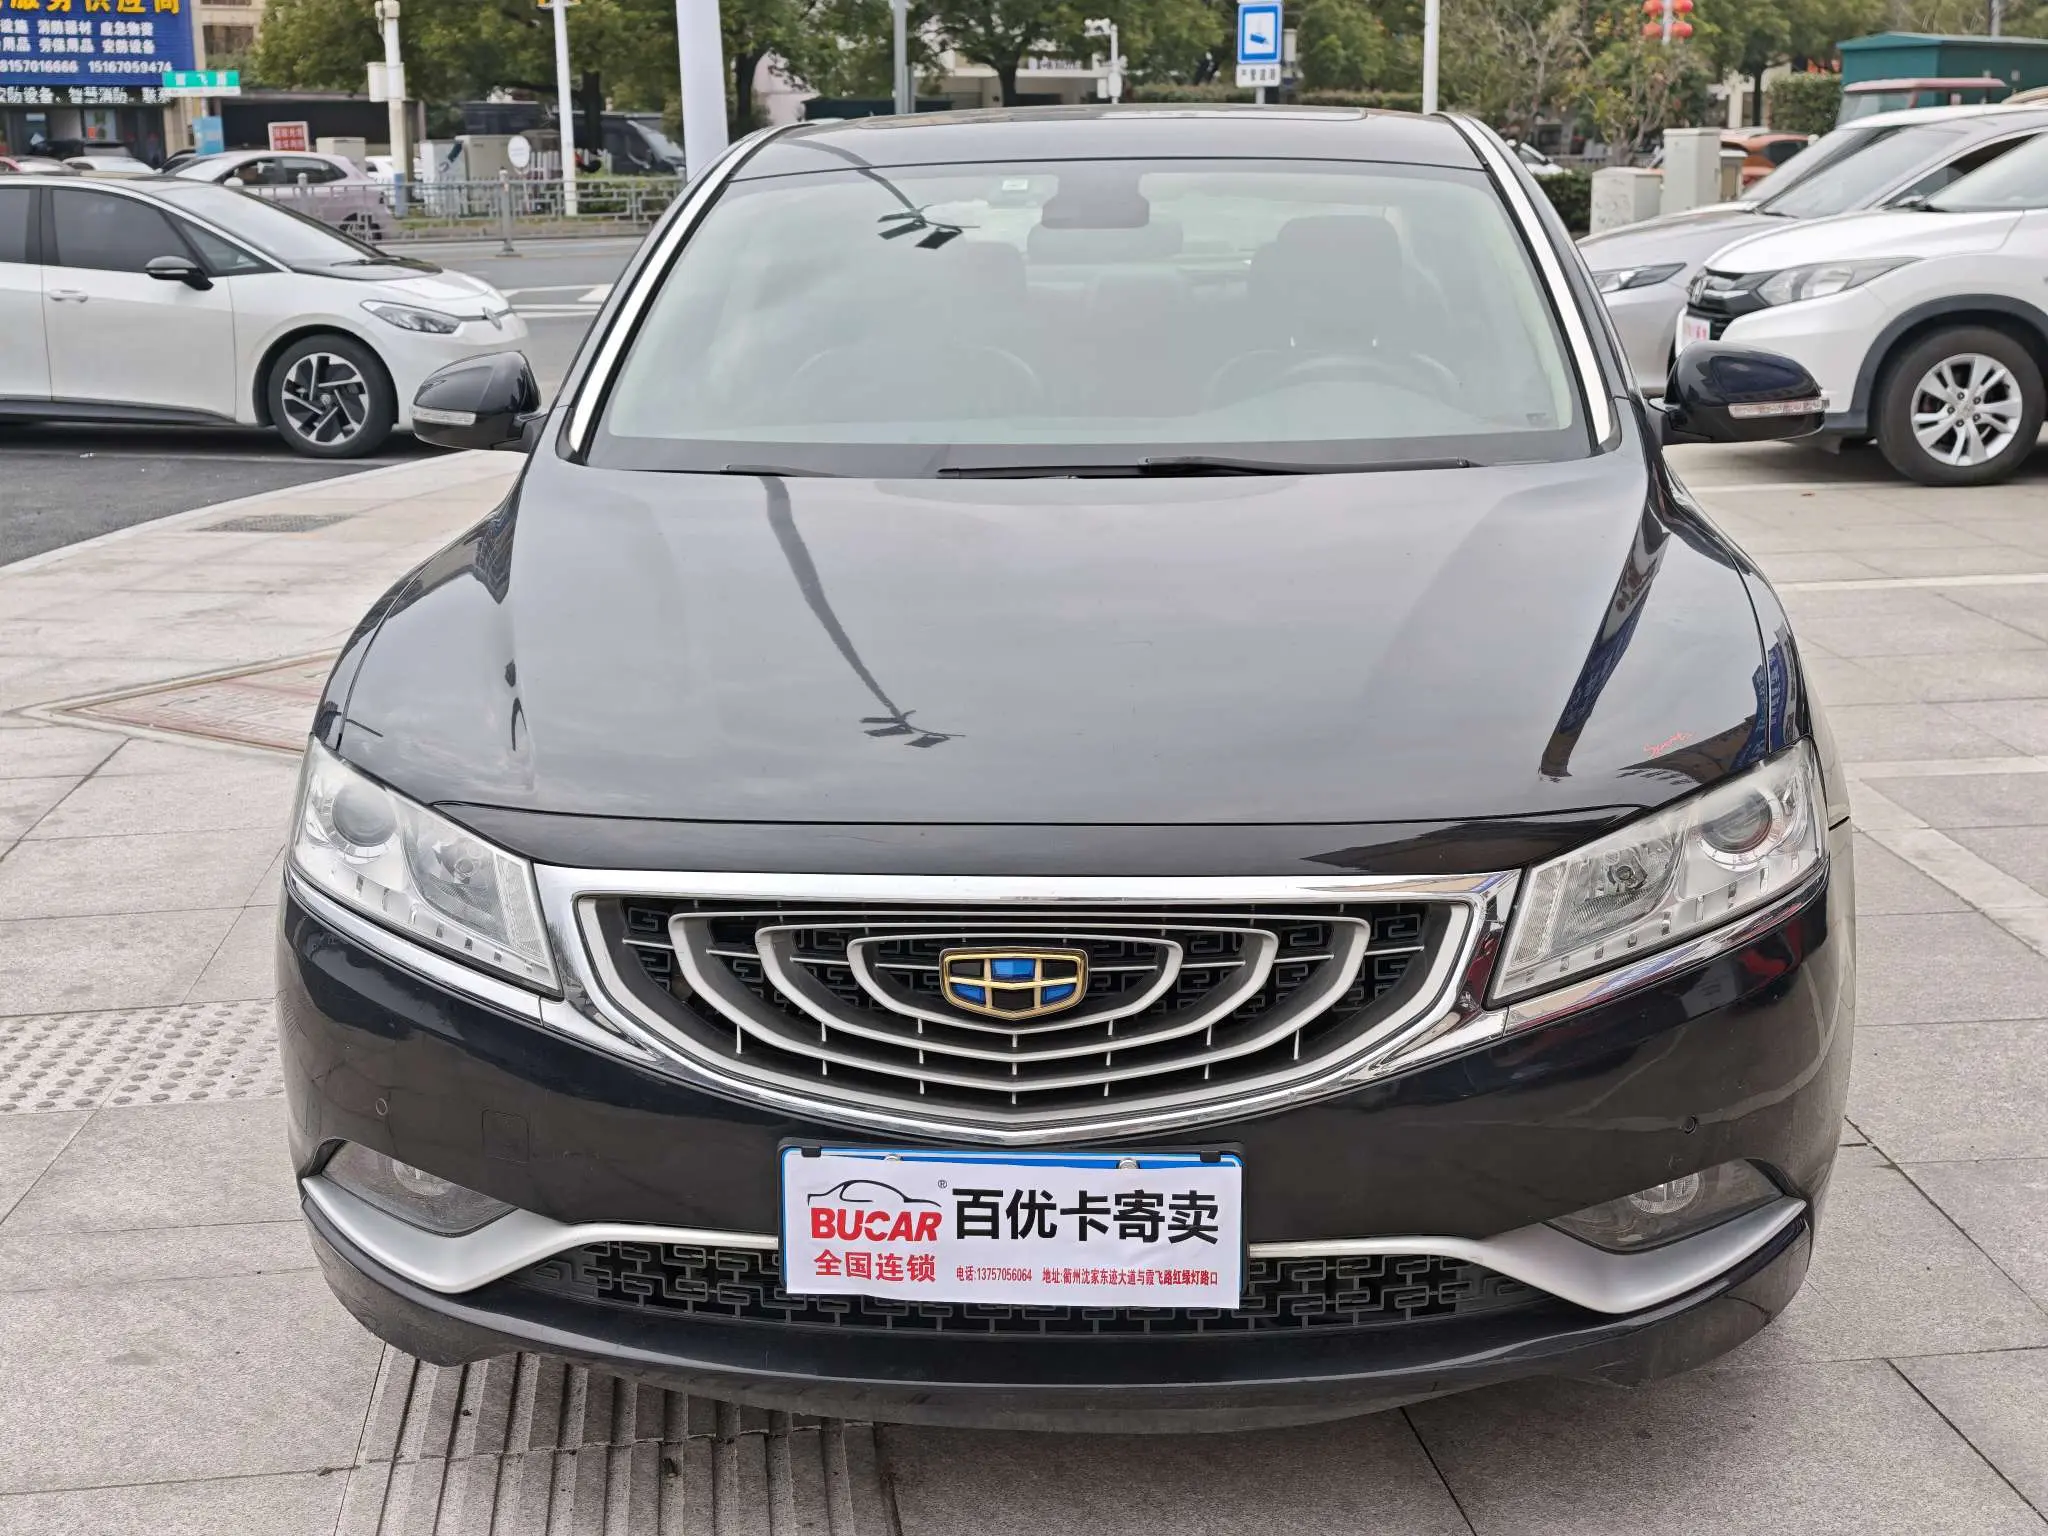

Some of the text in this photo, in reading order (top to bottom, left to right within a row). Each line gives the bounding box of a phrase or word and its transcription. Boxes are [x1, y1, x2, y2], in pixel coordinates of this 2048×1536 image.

[811, 1207, 943, 1242] BUCAR
[952, 1188, 1219, 1244] 百优卡寄卖
[813, 1249, 936, 1282] 全国连锁
[956, 1265, 1032, 1282] 电话:13757056064
